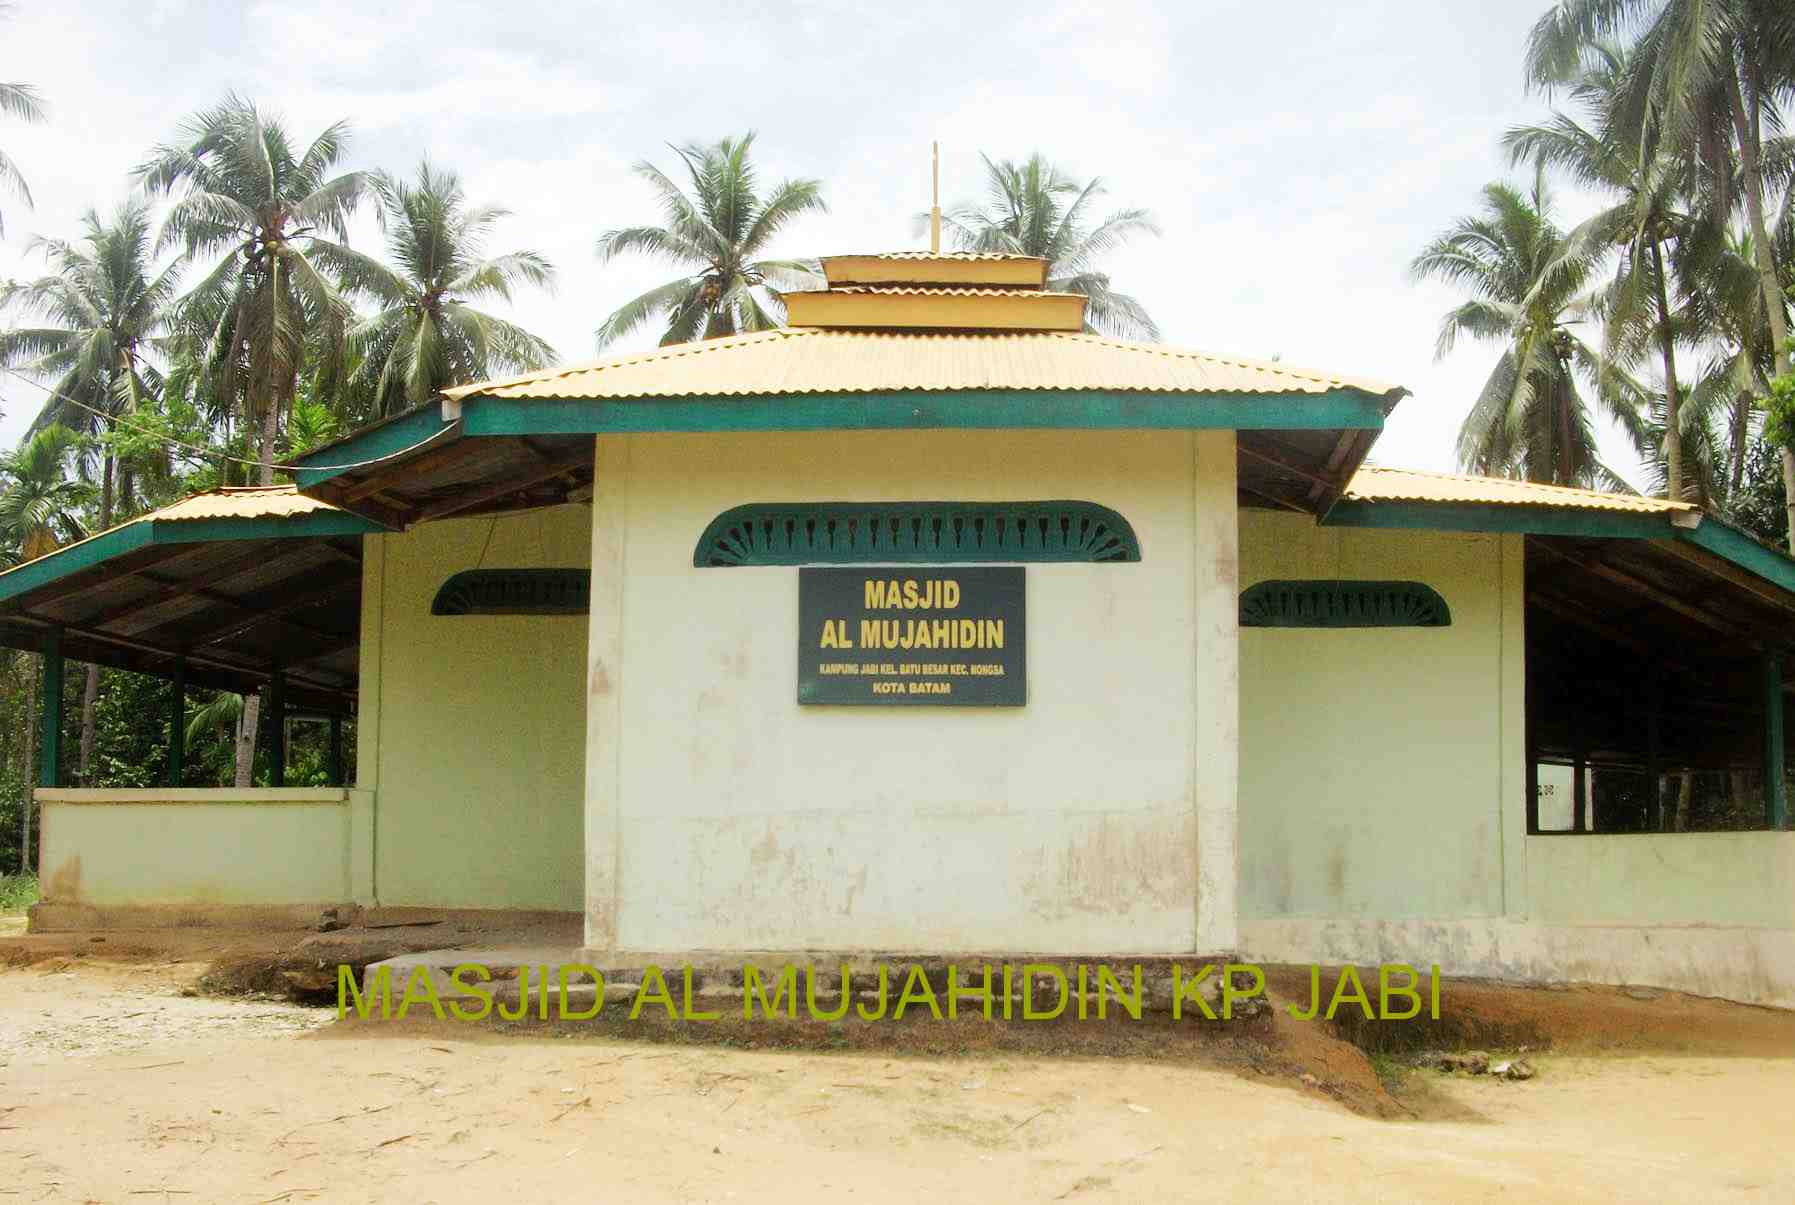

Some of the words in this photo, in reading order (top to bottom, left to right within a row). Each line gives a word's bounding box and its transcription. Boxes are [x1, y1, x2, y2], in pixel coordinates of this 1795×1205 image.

[864, 580, 961, 609] MASJID
[820, 619, 853, 649] AL
[860, 619, 1004, 650] MUJAHIDIN
[819, 663, 859, 675] KAMPUNG
[872, 682, 906, 694] KOTA
[908, 682, 951, 694] BATAM
